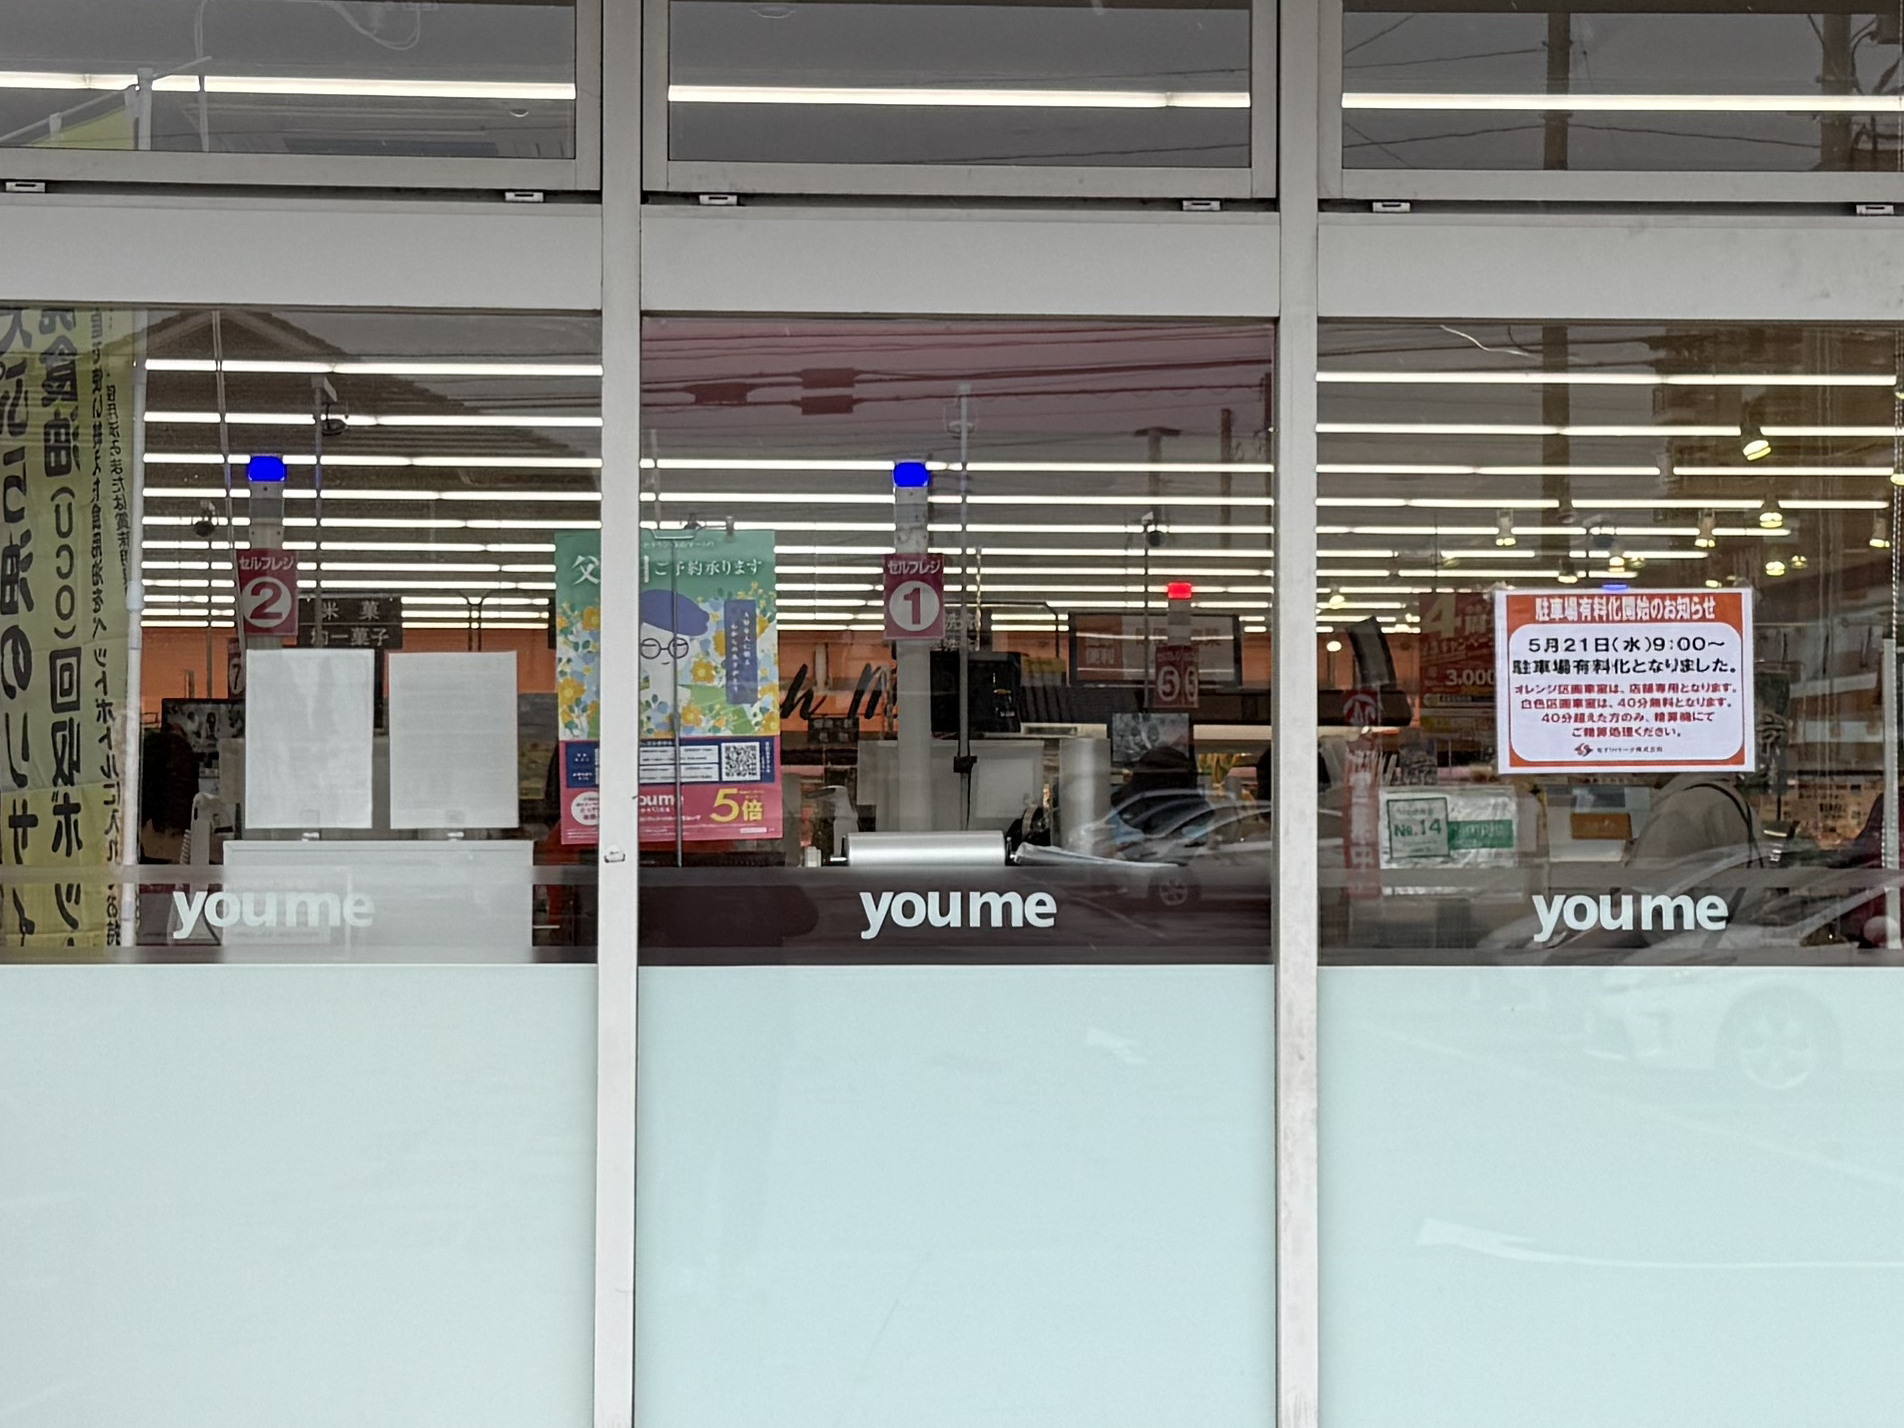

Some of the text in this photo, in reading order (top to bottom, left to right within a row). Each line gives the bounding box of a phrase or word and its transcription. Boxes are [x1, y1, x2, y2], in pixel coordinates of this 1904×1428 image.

[239, 556, 294, 570] セルフレジ
[887, 560, 940, 575] セルフレジ
[250, 581, 283, 620] 2
[903, 587, 921, 625] 1
[1535, 596, 1716, 622] 駐車場有料化開始のお知らせ
[1512, 658, 1737, 675] 駐車場有料化となりました。
[172, 890, 377, 940] youme
[859, 891, 1058, 940] youme
[1531, 894, 1729, 943] youme
